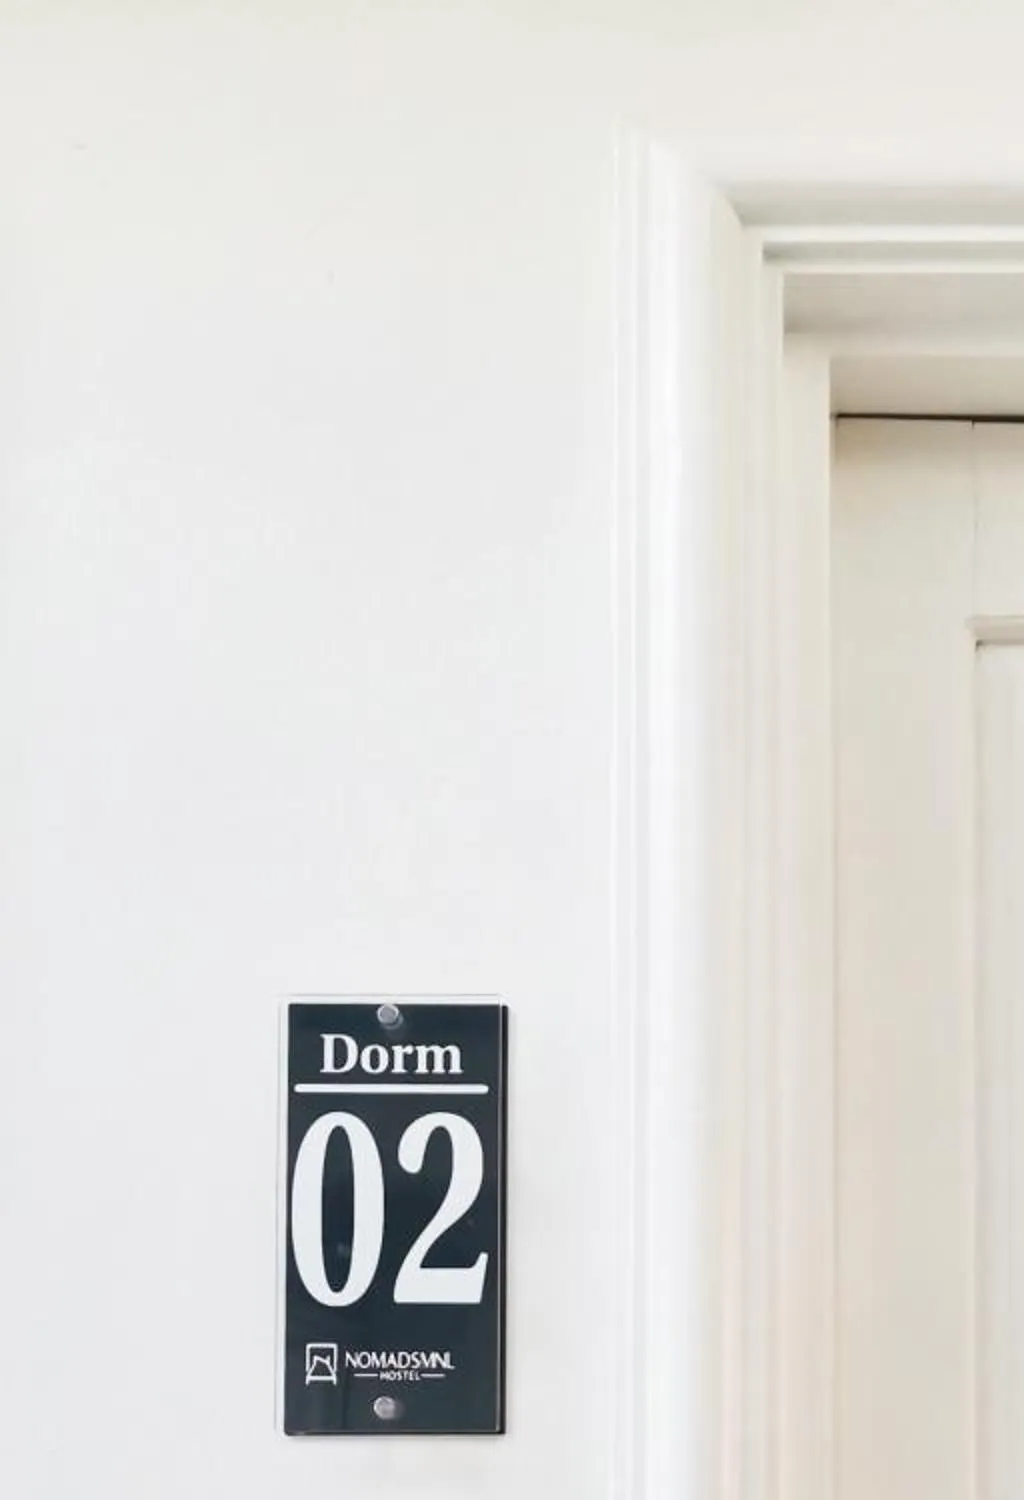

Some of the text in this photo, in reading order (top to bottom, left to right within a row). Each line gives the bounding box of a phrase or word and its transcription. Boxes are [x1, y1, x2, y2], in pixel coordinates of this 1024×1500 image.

[319, 1033, 463, 1074] Dorm
[291, 1111, 489, 1307] 02
[379, 1370, 421, 1381] HOSTEL
